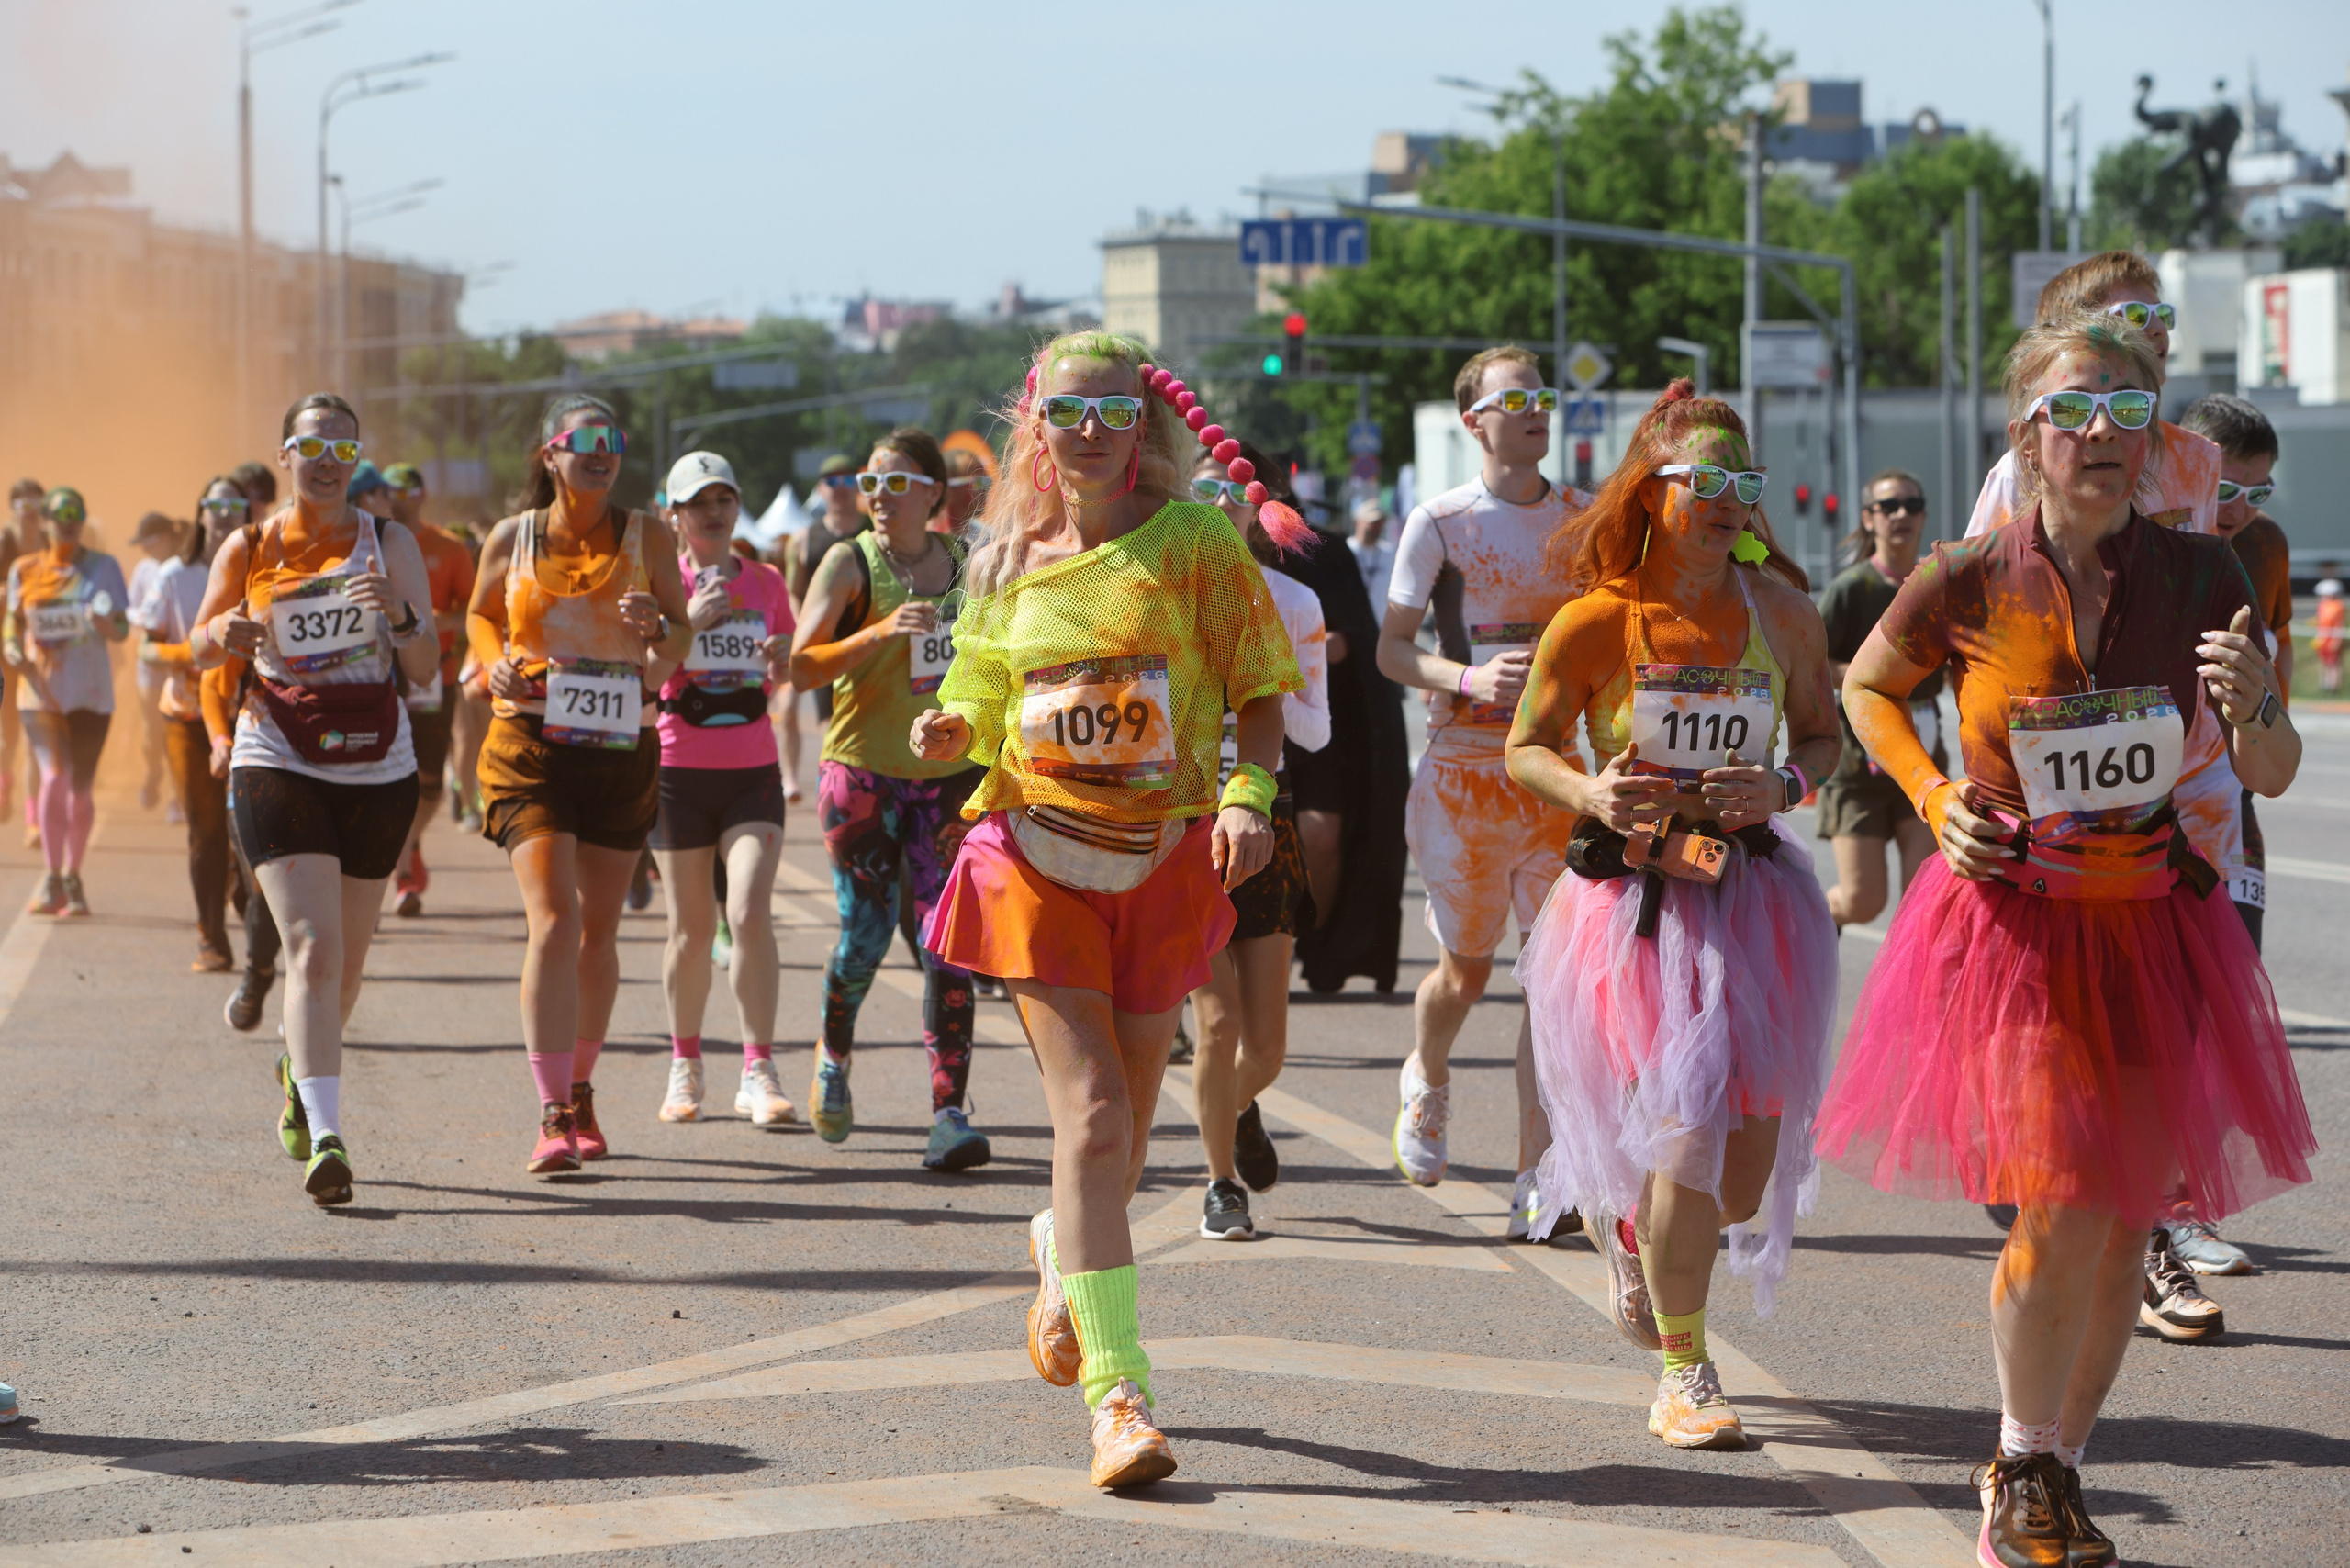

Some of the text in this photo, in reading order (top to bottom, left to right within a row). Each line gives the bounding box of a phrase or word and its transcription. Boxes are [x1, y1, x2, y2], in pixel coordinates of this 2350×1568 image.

[288, 606, 363, 642] 3372
[698, 634, 755, 659] 1589
[923, 636, 957, 663] 80
[1105, 671, 1166, 685] 2026
[1649, 667, 1762, 687] КРАСОЧНЫЙ
[564, 687, 623, 719] 7311
[1717, 686, 1769, 699] 2026
[2025, 690, 2165, 720] КРАСОЧНЫЙ
[1047, 701, 1149, 747] 1099
[2106, 706, 2177, 724] 2026
[1662, 711, 1749, 751] 1110
[2044, 743, 2154, 791] 1160
